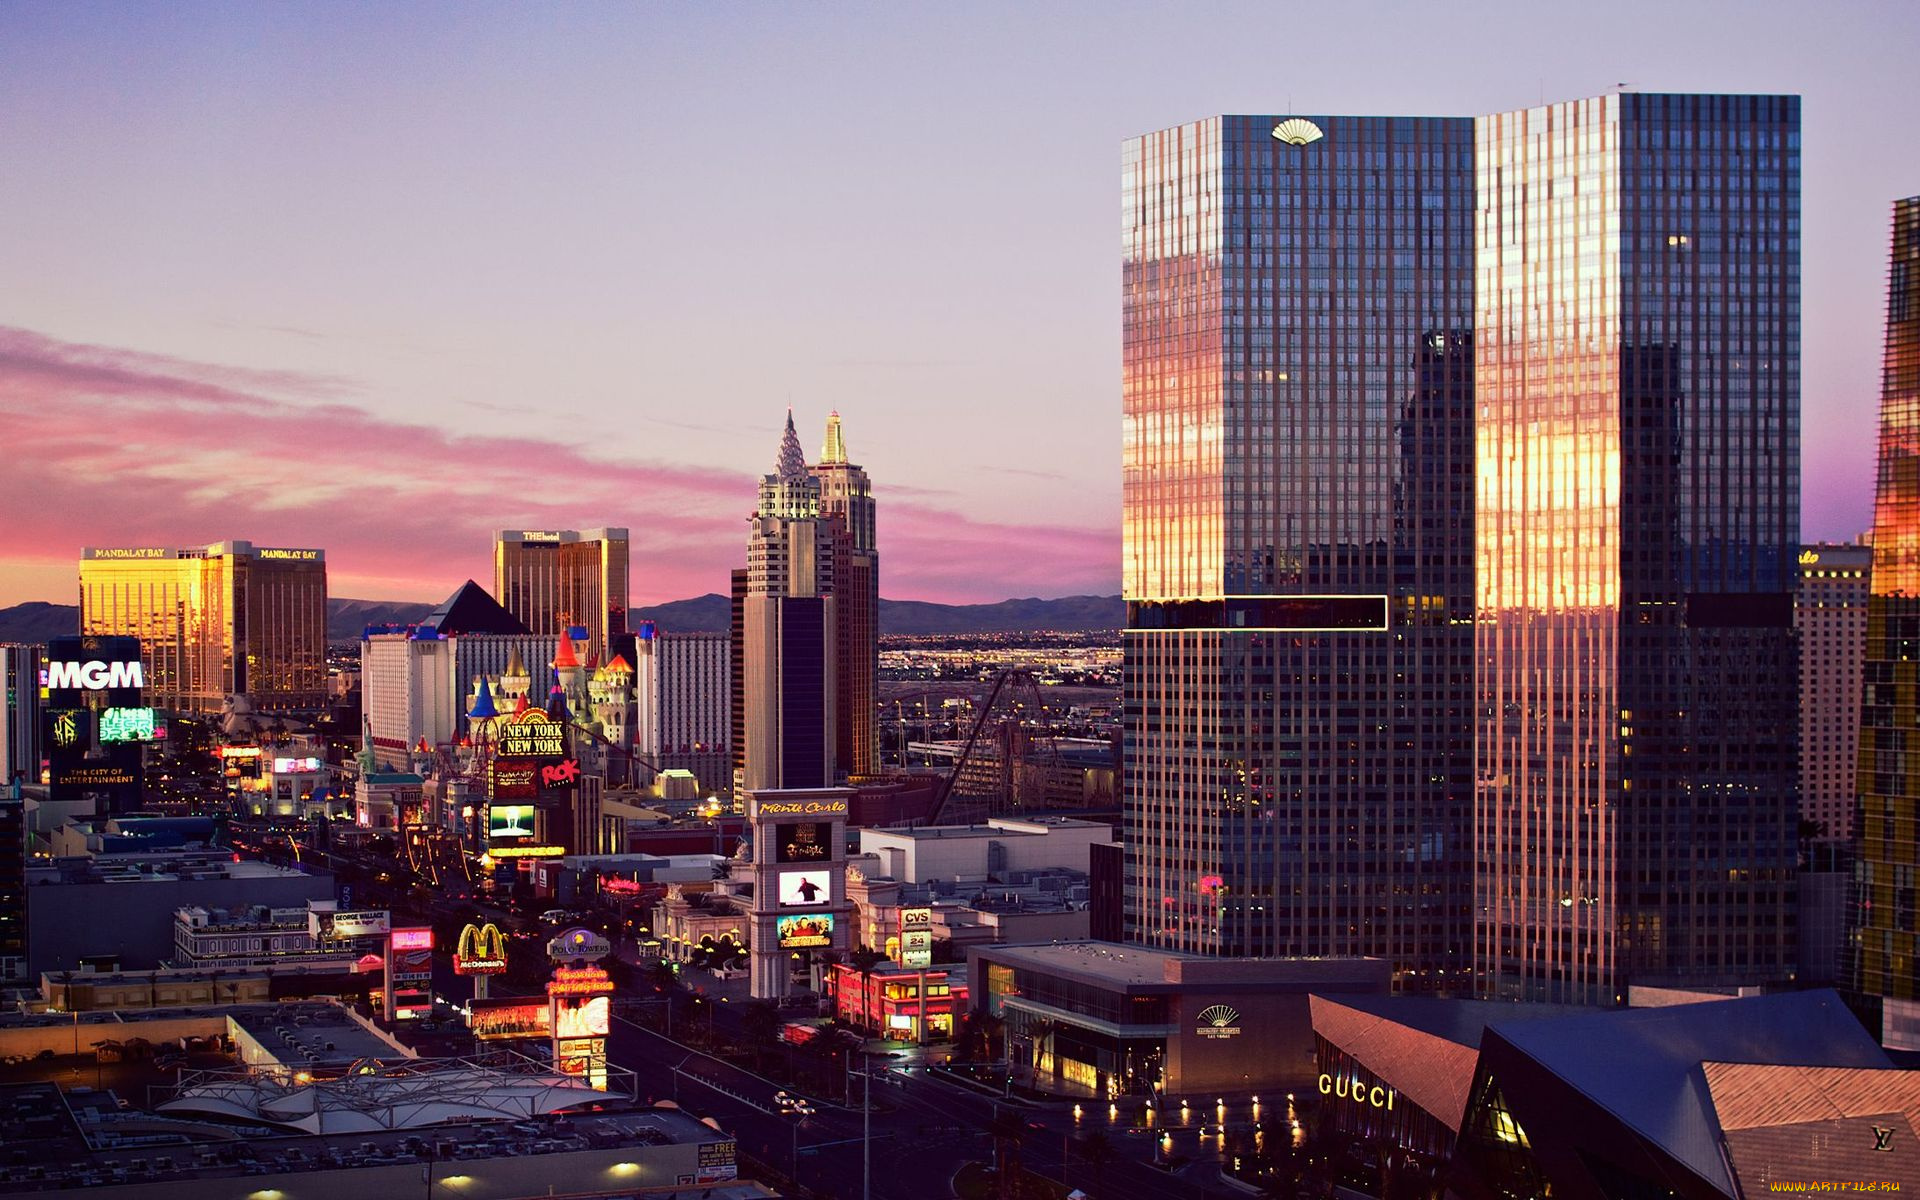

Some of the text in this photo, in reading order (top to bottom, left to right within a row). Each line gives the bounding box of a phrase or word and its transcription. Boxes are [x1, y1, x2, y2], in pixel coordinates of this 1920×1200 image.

[522, 531, 560, 541] THEhotel
[95, 549, 165, 558] MANDALAY BAY
[260, 549, 316, 559] MANDALAY BAY
[48, 660, 144, 690] MGM
[507, 724, 563, 738] NEW YORK
[507, 740, 563, 753] NEW YORK
[60, 775, 135, 784] ENTERTAINMENT
[759, 801, 846, 815] Monte Carlo
[335, 911, 385, 921] GEORGE WALLACE
[905, 912, 929, 923] CVS
[910, 937, 925, 945] 24
[1318, 1073, 1394, 1111] GUCCI
[715, 1143, 736, 1152] FREE
